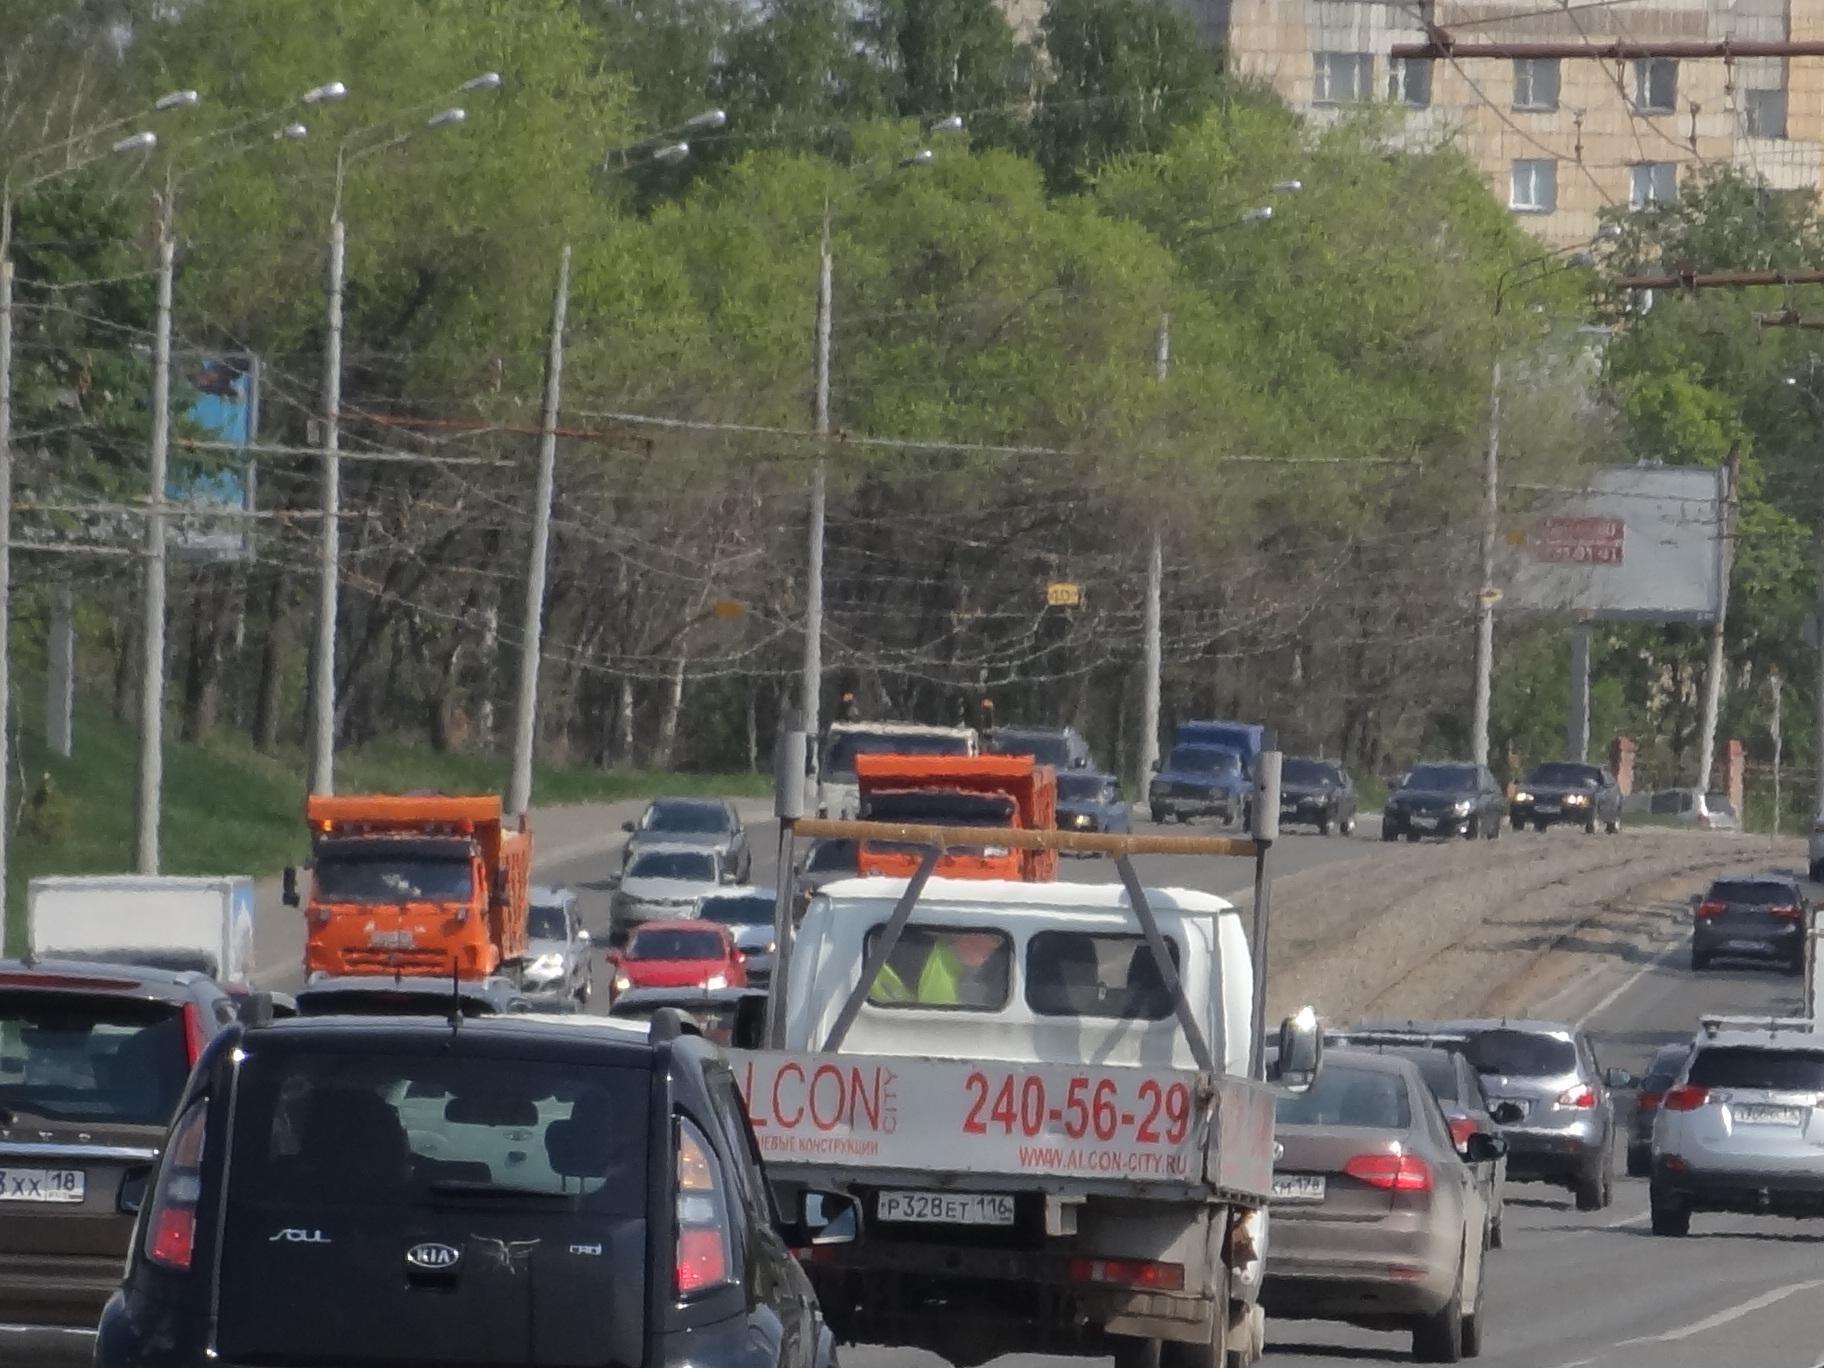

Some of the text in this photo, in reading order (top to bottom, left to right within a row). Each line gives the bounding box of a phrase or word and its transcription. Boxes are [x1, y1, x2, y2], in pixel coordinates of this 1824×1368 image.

[744, 1061, 881, 1132] LCON
[882, 1066, 898, 1135] CITY
[962, 1071, 1191, 1145] 240-56-29
[50, 1172, 75, 1191] 18
[976, 1197, 1009, 1215] 116
[416, 1248, 450, 1264] KIA
